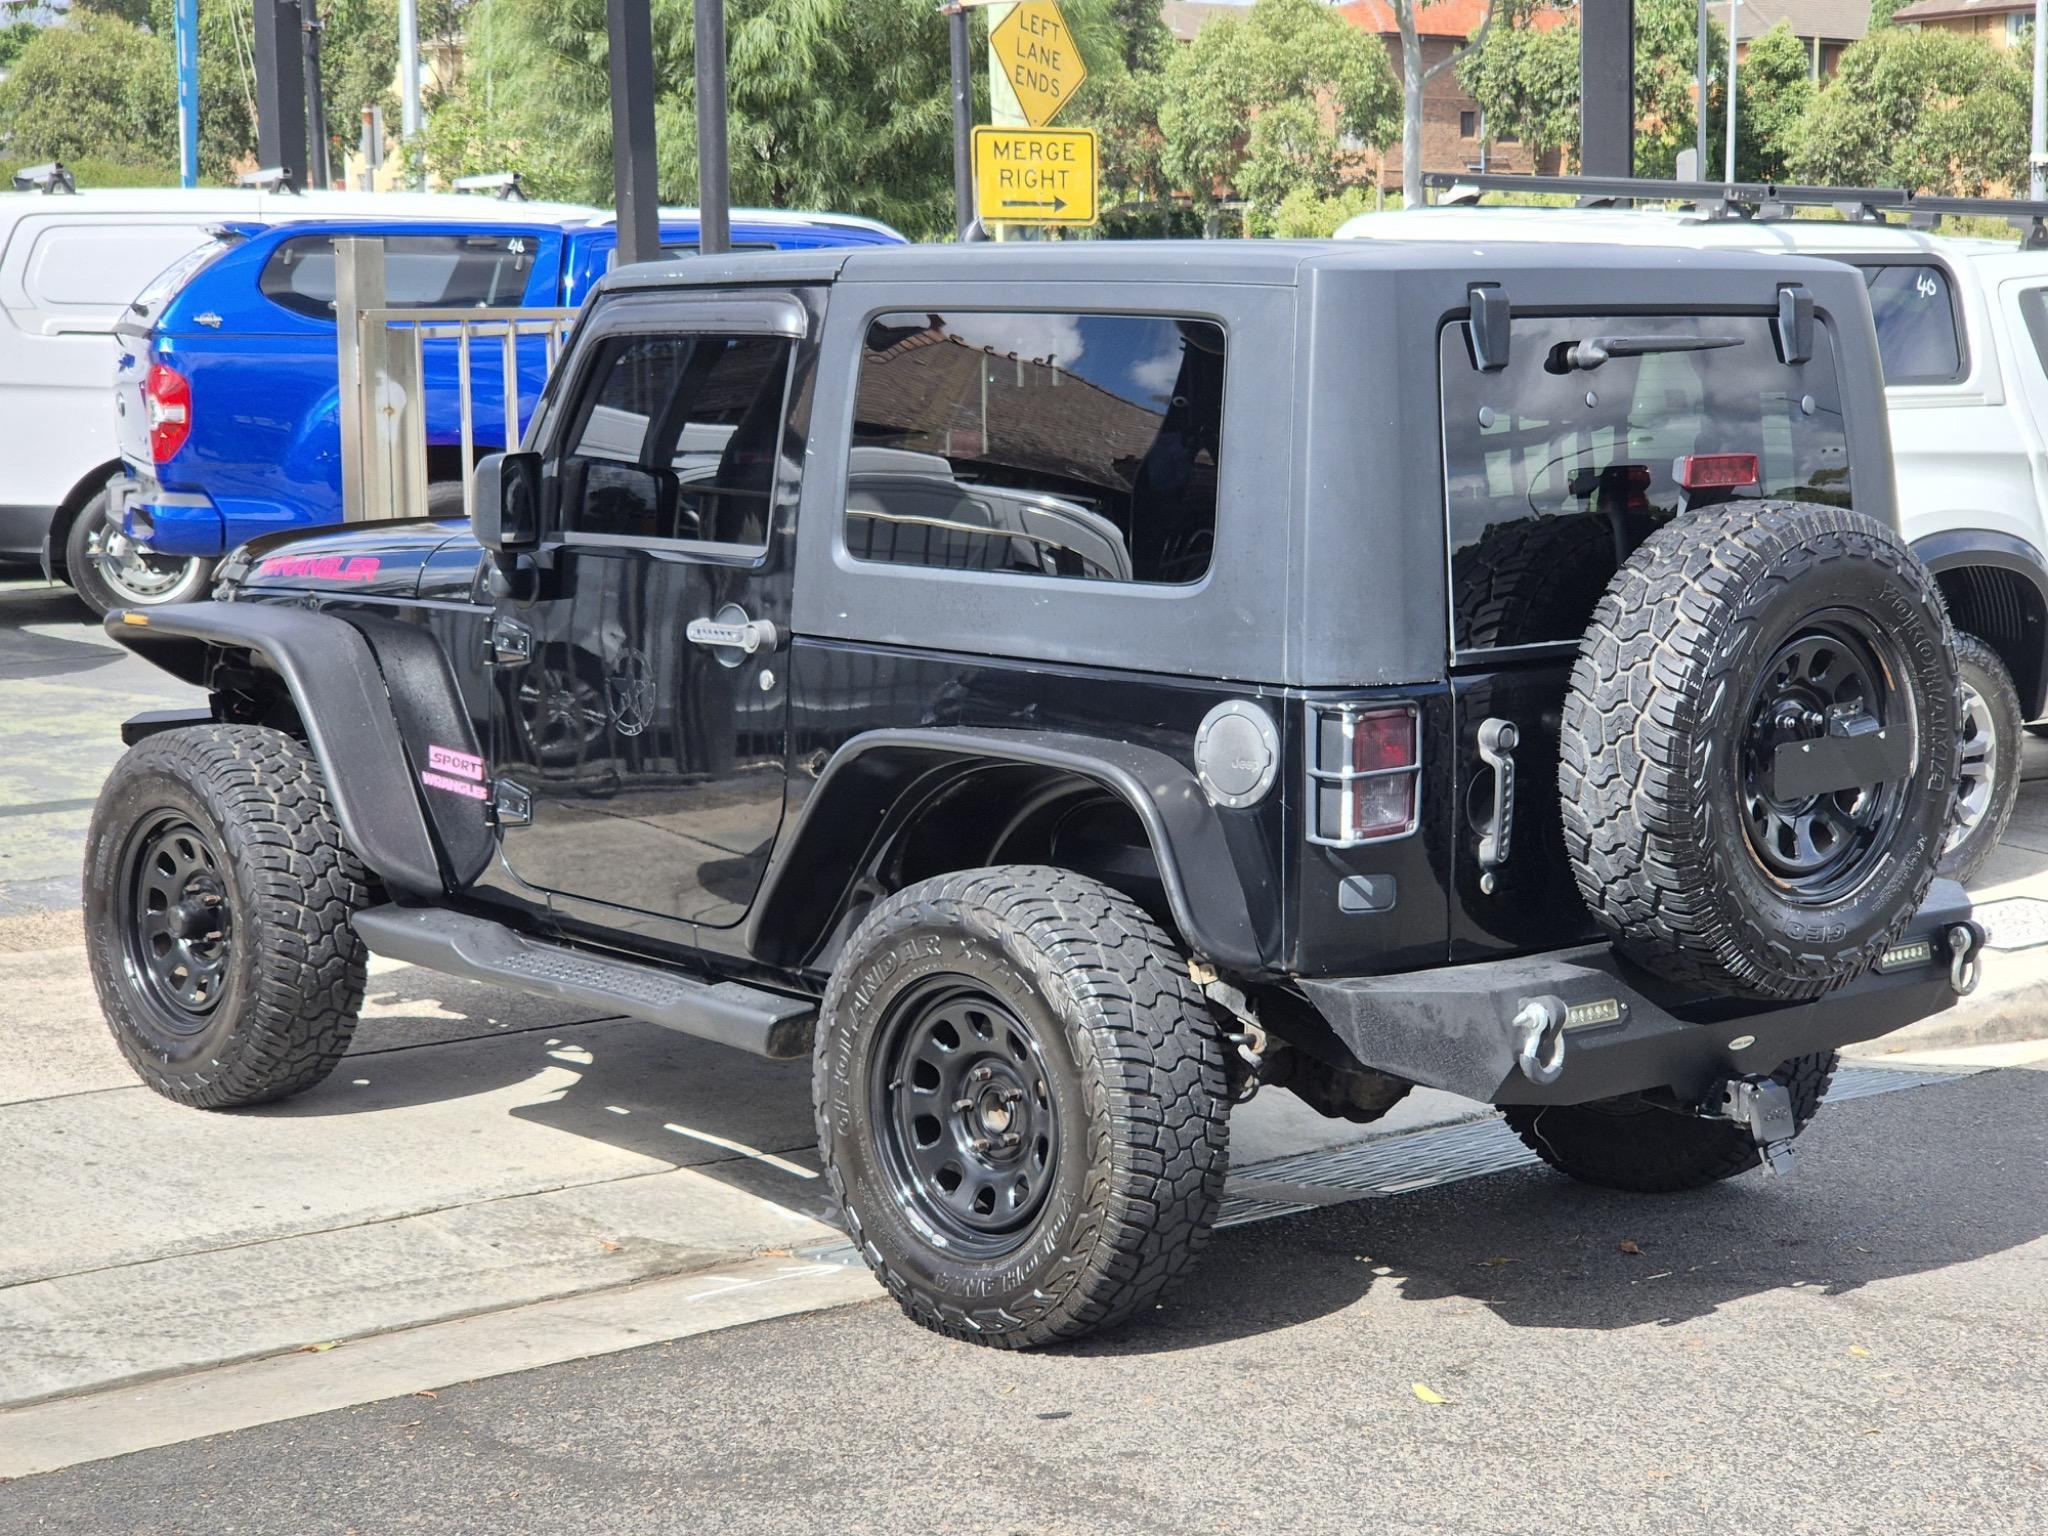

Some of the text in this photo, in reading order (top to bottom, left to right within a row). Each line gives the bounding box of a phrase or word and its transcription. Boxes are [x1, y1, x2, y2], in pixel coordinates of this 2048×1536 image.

[1020, 10, 1060, 41] LEFT
[1016, 37, 1061, 71] LANE
[1015, 65, 1060, 98] ENDS
[993, 141, 1076, 162] MERGE
[1000, 169, 1070, 189] RIGHT
[259, 556, 380, 582] WRANGLER
[431, 752, 483, 773] SPORT
[1231, 757, 1261, 773] Jeep
